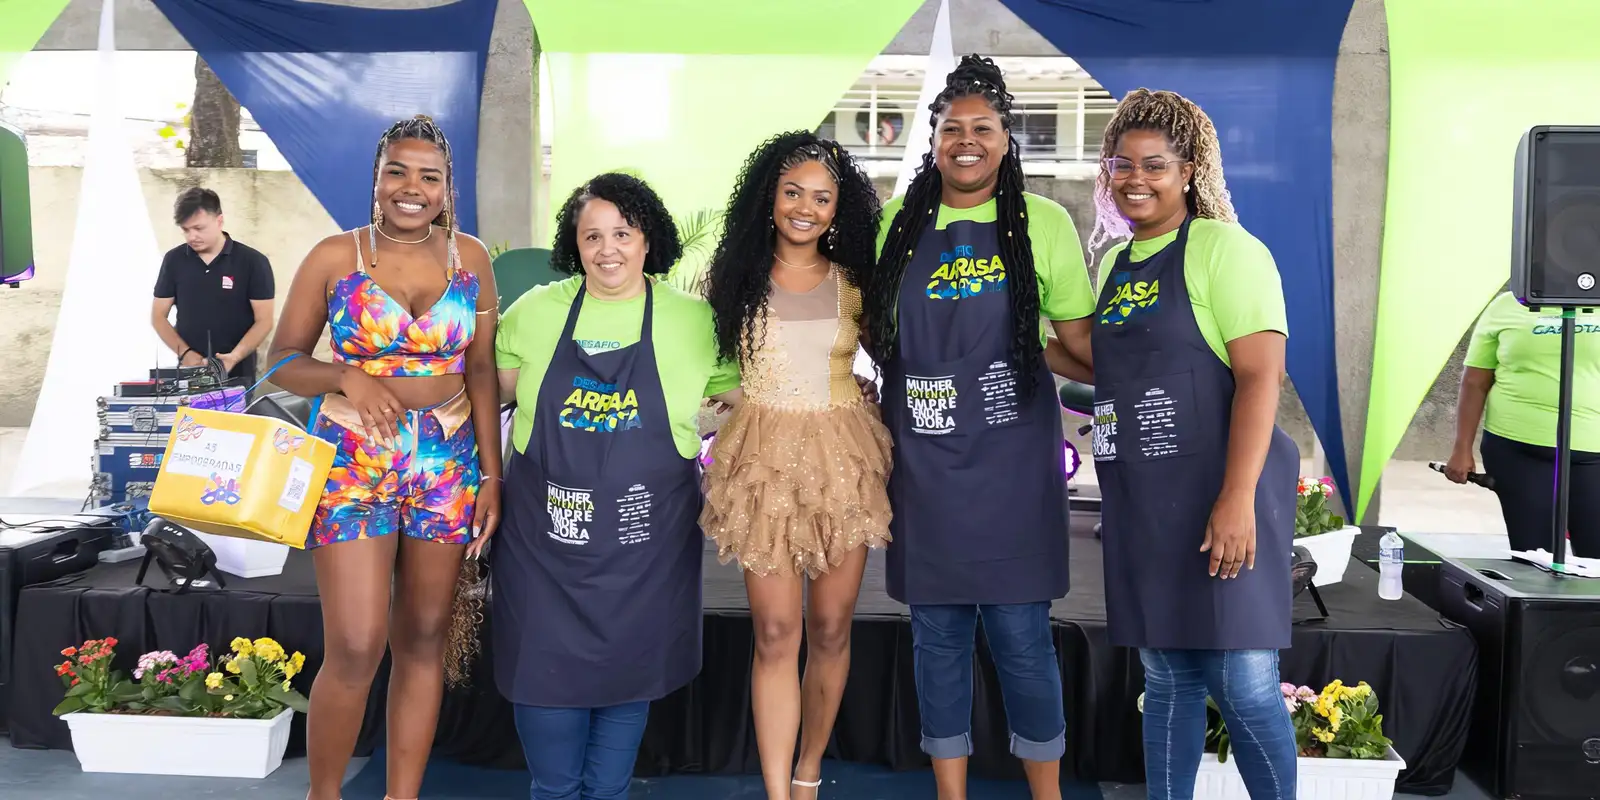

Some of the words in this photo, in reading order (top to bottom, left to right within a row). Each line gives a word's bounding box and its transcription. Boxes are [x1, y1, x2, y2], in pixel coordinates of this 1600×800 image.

[906, 378, 954, 392] MULHER
[907, 396, 957, 412] EMPRE
[916, 416, 956, 428] DORA
[547, 485, 591, 503] MULHER
[547, 501, 593, 522] EMPRE
